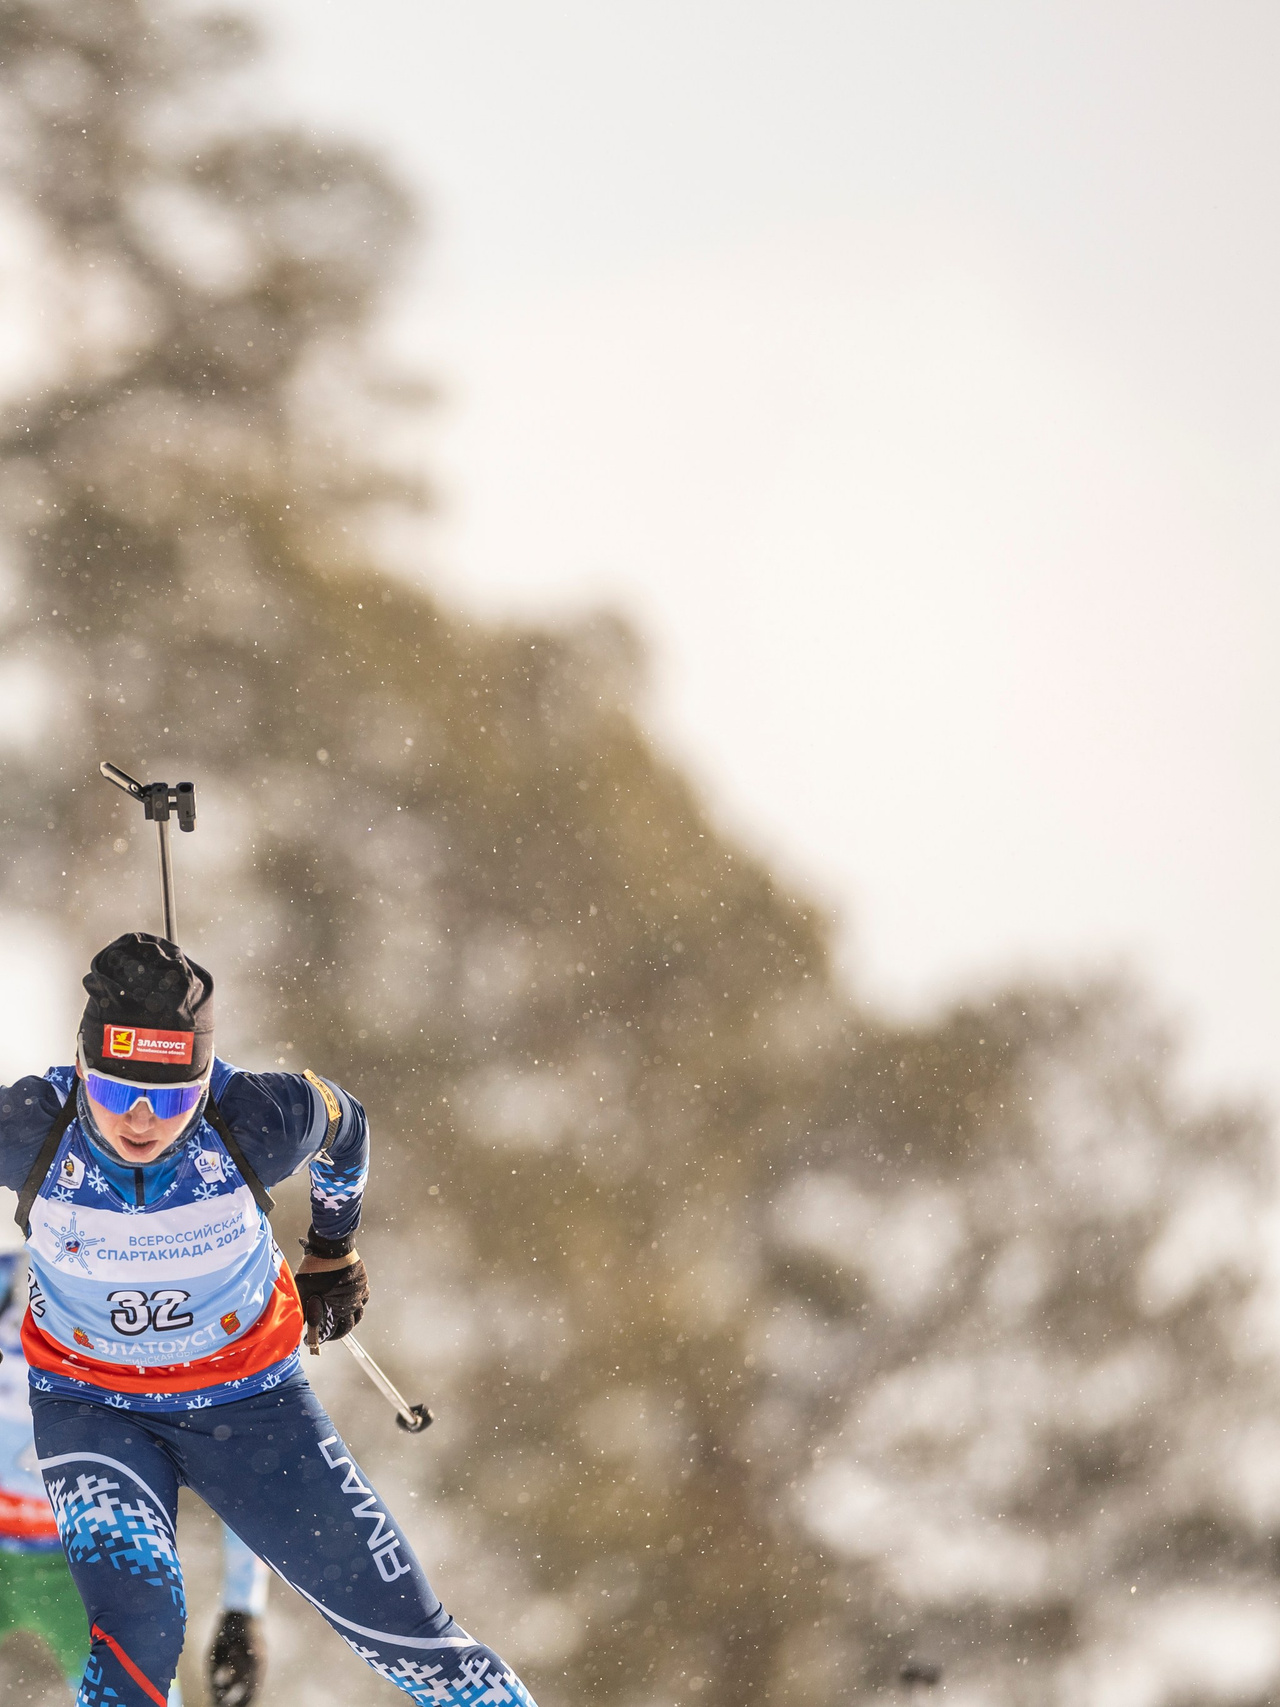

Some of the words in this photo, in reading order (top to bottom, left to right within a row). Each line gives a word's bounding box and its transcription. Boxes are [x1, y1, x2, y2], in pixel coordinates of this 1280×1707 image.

[137, 1038, 186, 1050] ЗЛАТОУСТ
[96, 1241, 213, 1262] СПАРТАКИАДА
[216, 1223, 246, 1248] 2024
[128, 1211, 243, 1247] ВСЕРОССИЙСКАЯ
[107, 1290, 193, 1336] 32
[95, 1322, 217, 1357] ЗЛАТОУСТ
[317, 1435, 411, 1583] ЯМАЛ
